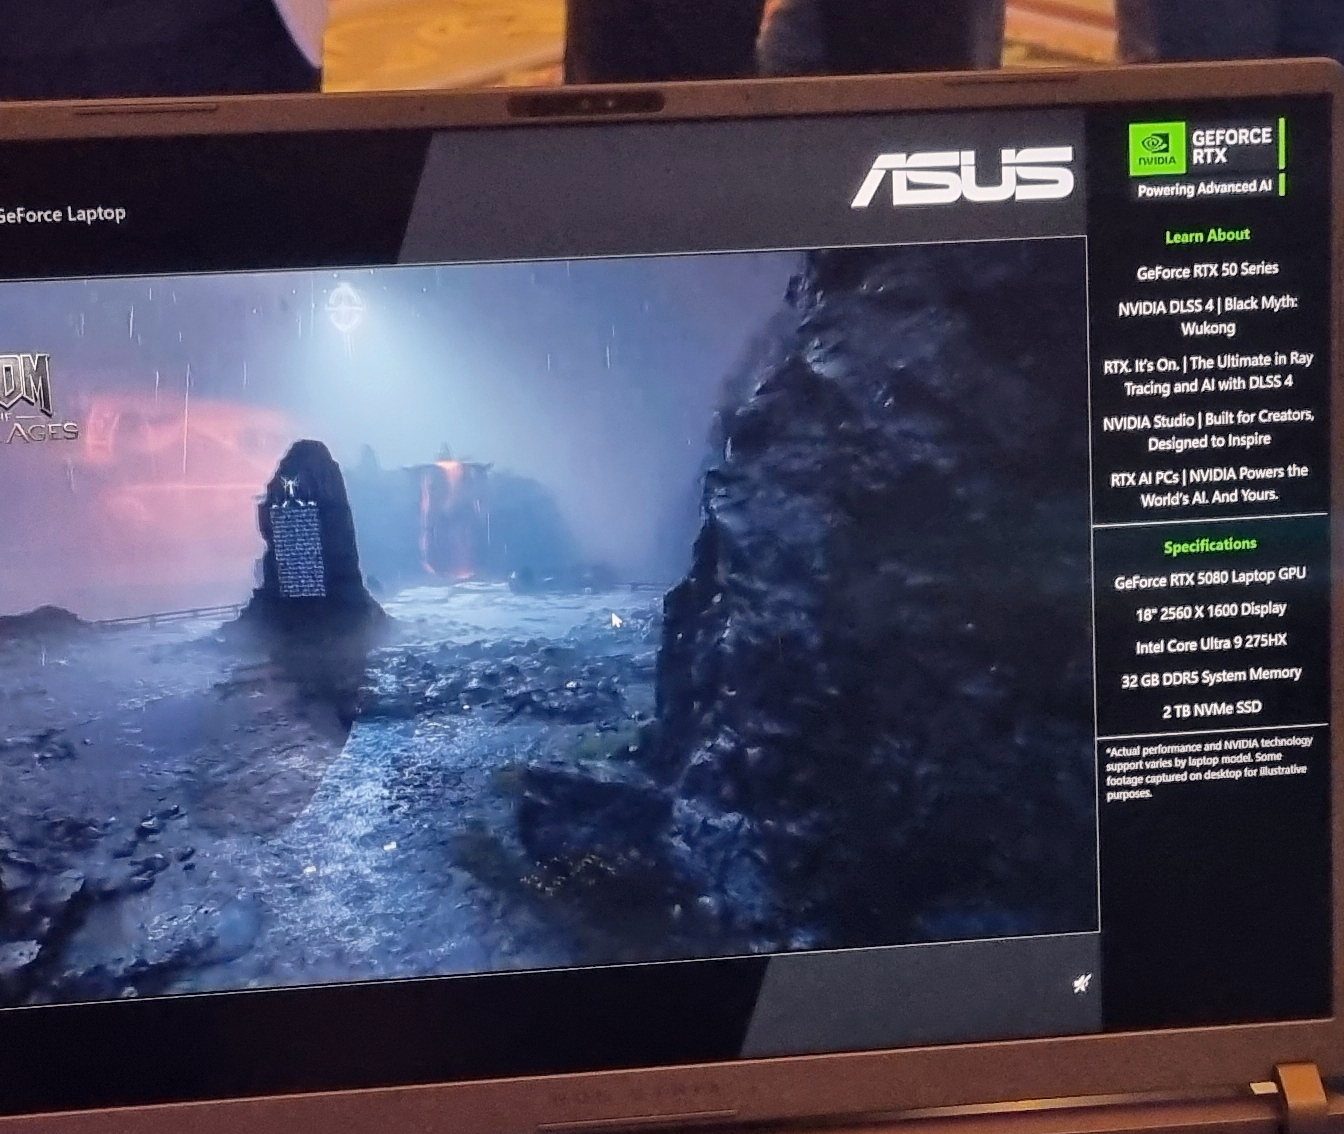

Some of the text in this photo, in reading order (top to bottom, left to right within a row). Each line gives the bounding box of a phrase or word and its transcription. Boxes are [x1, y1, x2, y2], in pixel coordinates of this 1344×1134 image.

[1193, 128, 1272, 146] GEFORCE
[1138, 155, 1177, 167] NVIDIA
[1193, 148, 1227, 164] RTX
[851, 147, 1074, 207] ASUS
[1138, 179, 1272, 197] Powering Advanced AI
[68, 206, 125, 224] Laptop
[1166, 228, 1250, 243] Learn About
[1137, 261, 1279, 280] GeForce RTX 50 Series
[1119, 295, 1297, 316] NVIDIA DLSS 4 Black Myth:
[1181, 321, 1235, 337] Wukong
[1105, 352, 1314, 374] RTX. It's On. The Ultimate in Ray
[1124, 374, 1293, 397] Tracing and AI with DLSS 4
[1104, 409, 1314, 430] NVIDIA Studio Built for Creators,
[1149, 432, 1271, 452] Designed to Inspire
[1112, 464, 1308, 486] RTX AI PCs NVIDIA Powers the
[1141, 492, 1189, 507] World's
[1212, 490, 1238, 503] And
[1241, 489, 1278, 501] Yours.
[1164, 537, 1257, 556] Specifications
[1115, 567, 1306, 589] GeForce RTX 5080 Laptop GPU
[1137, 601, 1287, 621] 18" 2560 X 1600 Display
[1137, 633, 1287, 654] Intel Core Ultra 9 275HX
[1122, 667, 1302, 688] 32 GB DDR5 System Memory
[1163, 700, 1262, 718] 2 TB NVMe SSD
